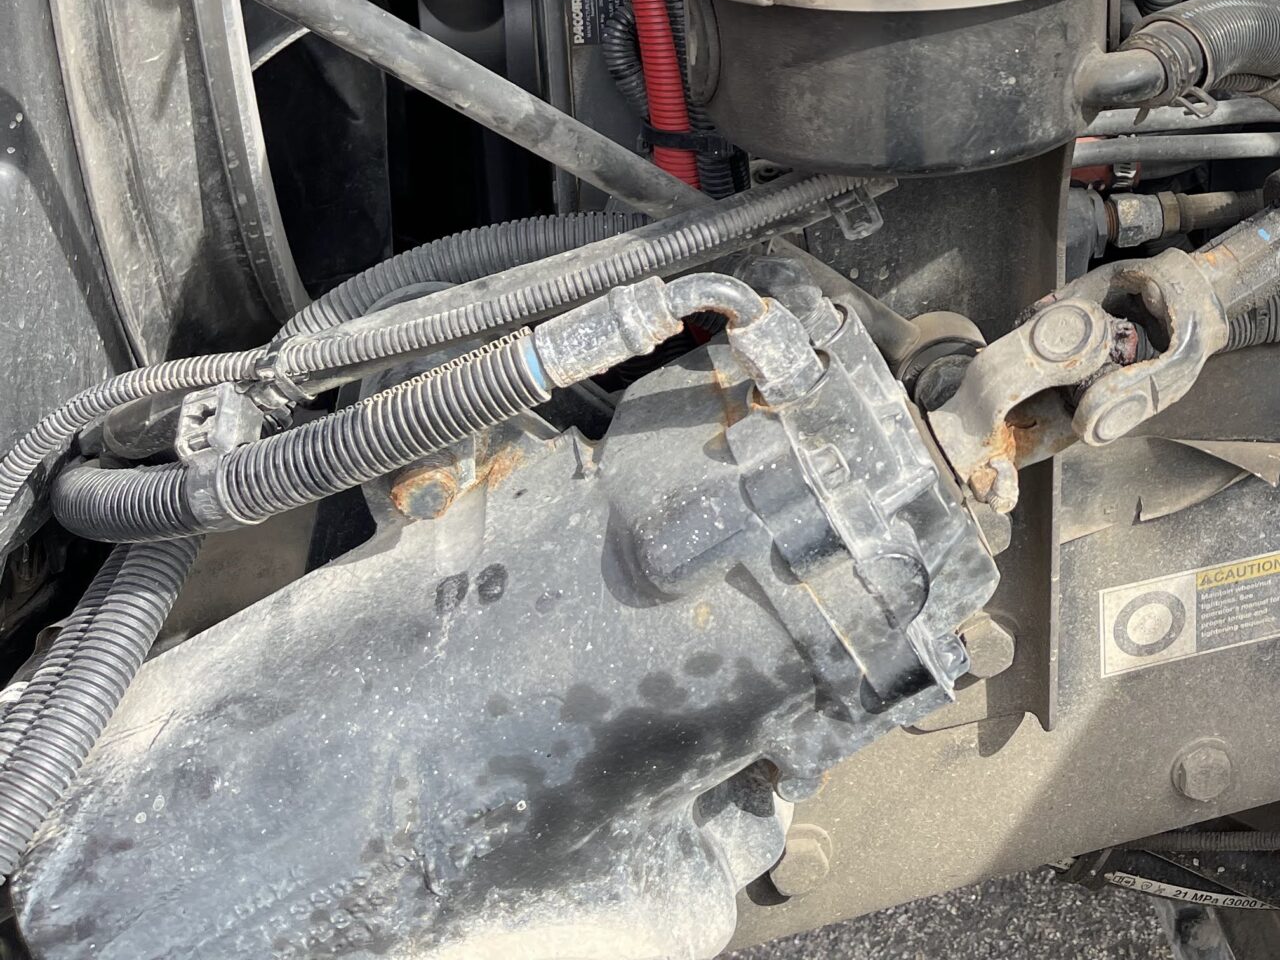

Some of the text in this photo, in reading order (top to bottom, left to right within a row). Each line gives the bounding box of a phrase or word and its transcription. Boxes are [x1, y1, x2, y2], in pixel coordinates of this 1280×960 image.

[1173, 889, 1188, 899] 21
[1191, 892, 1219, 905] MPa
[1222, 897, 1257, 908] (3000
